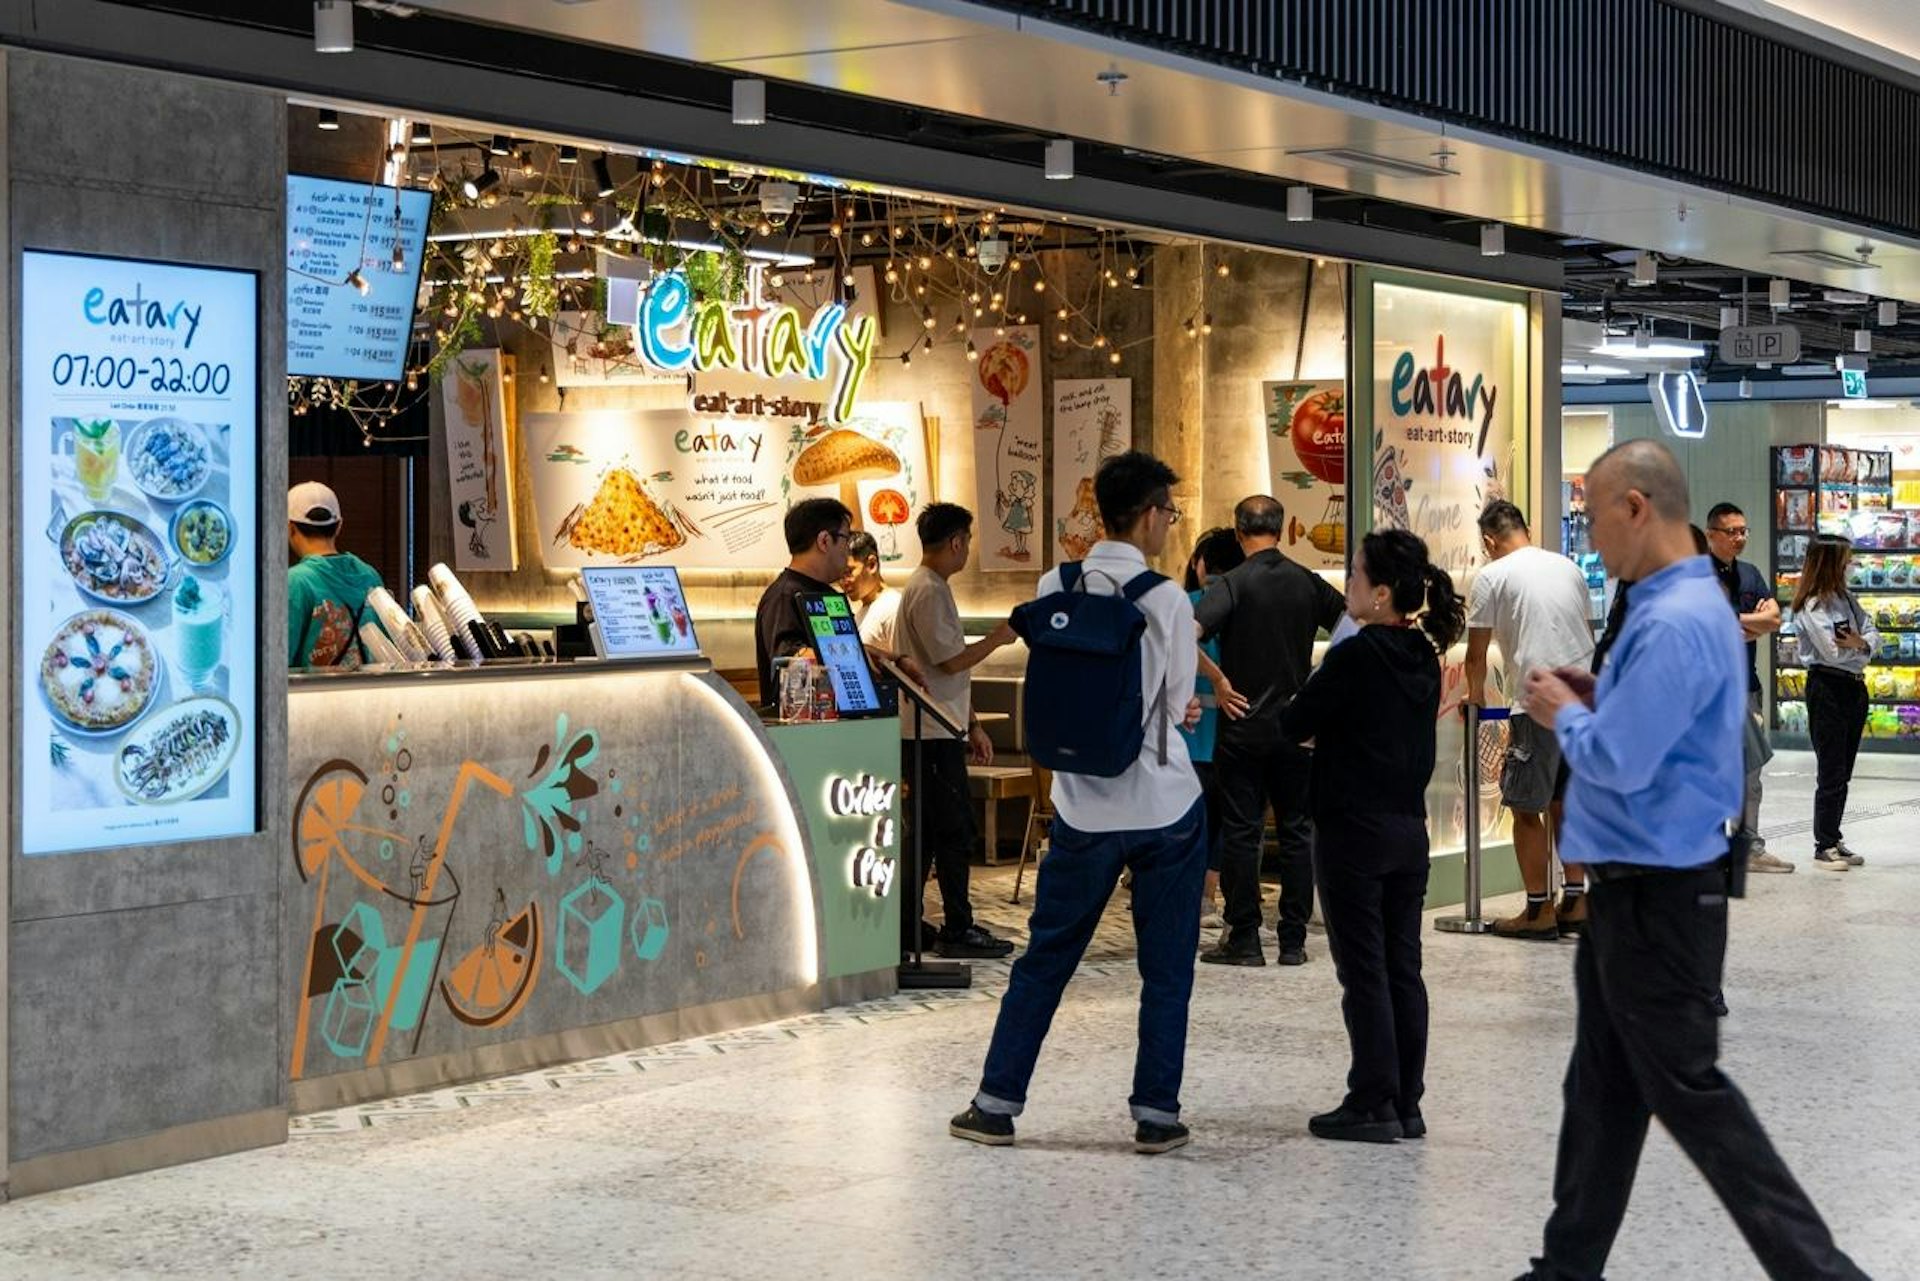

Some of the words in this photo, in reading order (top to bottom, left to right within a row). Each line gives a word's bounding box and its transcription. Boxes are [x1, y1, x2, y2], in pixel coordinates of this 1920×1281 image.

[84, 282, 202, 349] eatary
[639, 265, 876, 422] eatary
[53, 353, 231, 395] 07:00-22:00
[1391, 334, 1497, 459] eatary
[674, 423, 763, 463] eatary
[832, 775, 896, 816] Order
[854, 848, 895, 897] Pay
